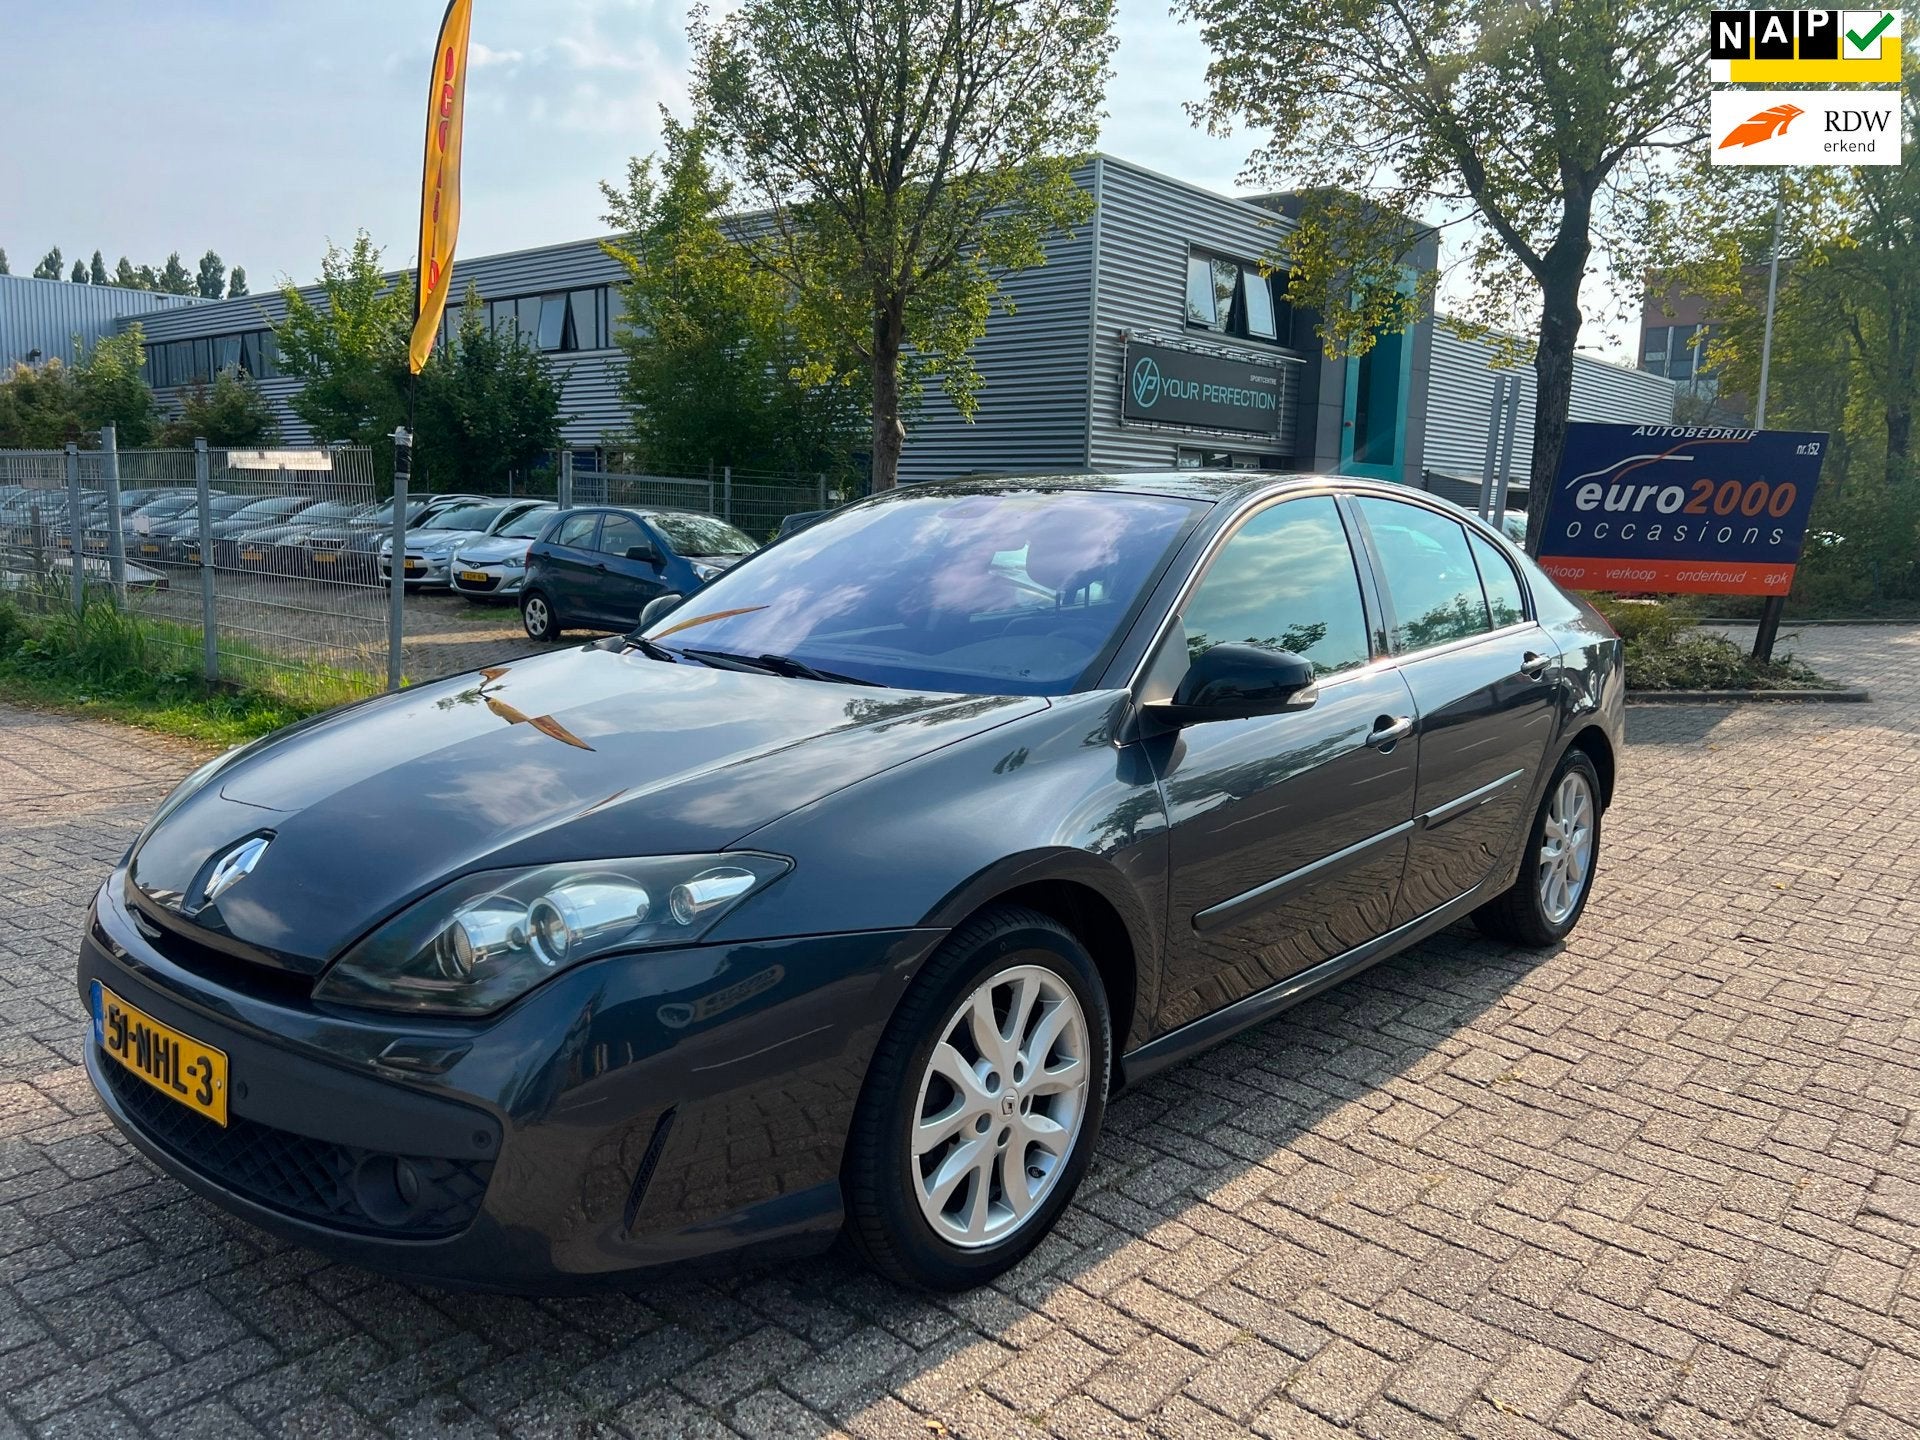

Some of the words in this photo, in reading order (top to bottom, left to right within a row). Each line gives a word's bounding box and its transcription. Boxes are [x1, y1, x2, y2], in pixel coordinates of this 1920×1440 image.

[1161, 377, 1199, 401] YOUR
[1202, 383, 1276, 411] PERFECTION
[1632, 426, 1759, 440] AUTOBEDRIJF
[1796, 442, 1820, 456] nr.152
[1575, 479, 1797, 518] euro2000
[1566, 521, 1784, 545] occasions
[1606, 567, 1657, 581] verkoop
[1676, 570, 1747, 583] onderhoud
[1764, 572, 1788, 586] apk
[108, 1004, 213, 1106] 51-NHL-3
